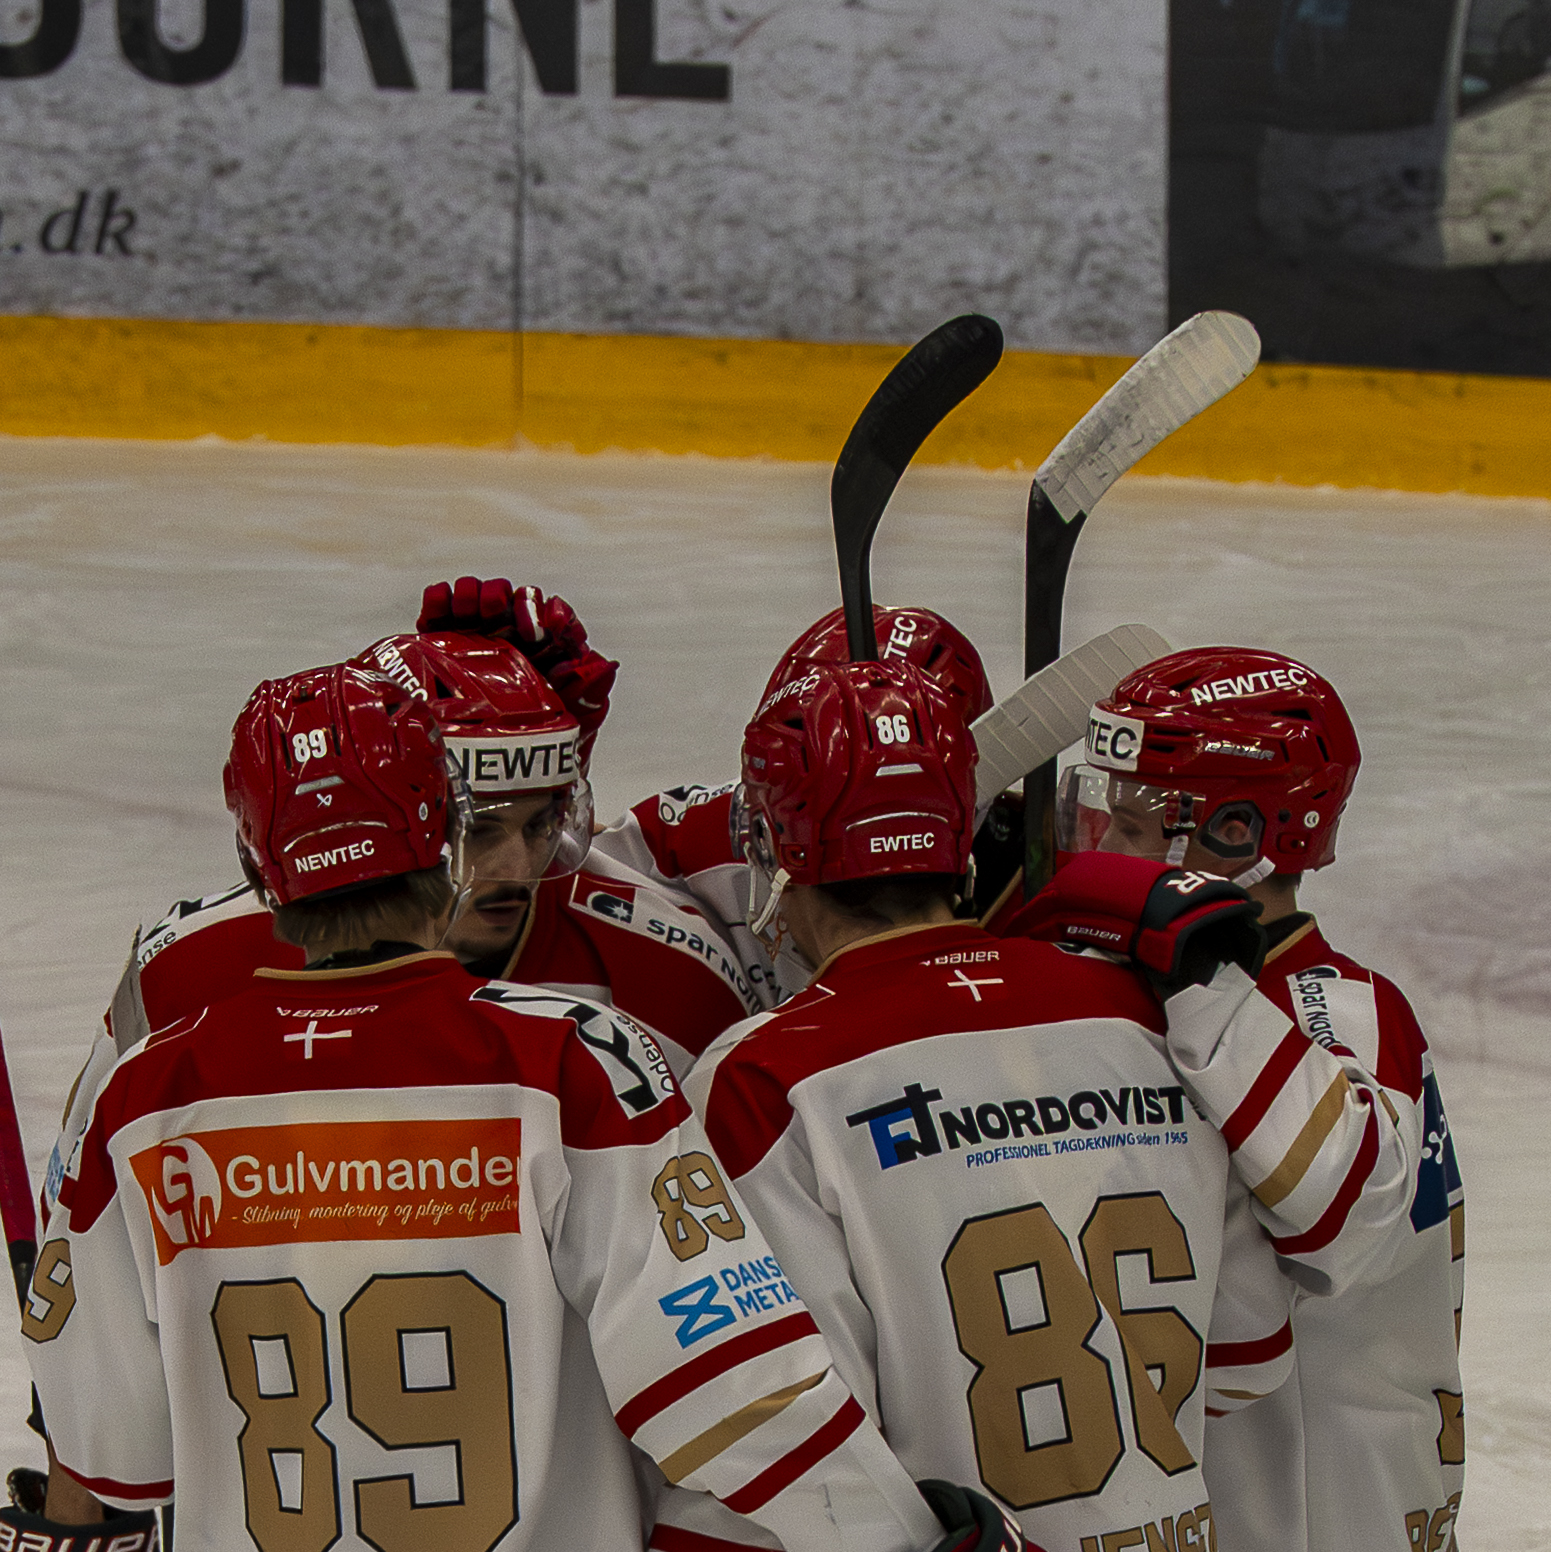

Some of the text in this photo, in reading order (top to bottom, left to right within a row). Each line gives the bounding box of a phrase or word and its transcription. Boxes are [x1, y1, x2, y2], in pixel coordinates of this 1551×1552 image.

[1190, 667, 1310, 707] NEWTEC
[291, 729, 328, 763] 89
[874, 714, 911, 746] 86
[1086, 717, 1138, 761] TEC
[447, 739, 576, 783] NEWTE
[294, 840, 376, 875] NEWTEC
[869, 832, 936, 855] EWTEC
[647, 918, 719, 961] spar
[1066, 925, 1122, 943] BAUER
[934, 950, 1000, 966] BAUER
[939, 1085, 1192, 1150] NORDQVIST
[966, 1138, 1052, 1168] PROFESSIONEL
[225, 1145, 520, 1199] Gulvmande
[393, 1203, 413, 1226] og
[458, 1196, 478, 1223] af
[651, 1150, 747, 1263] 89
[941, 1190, 1204, 1513] 86
